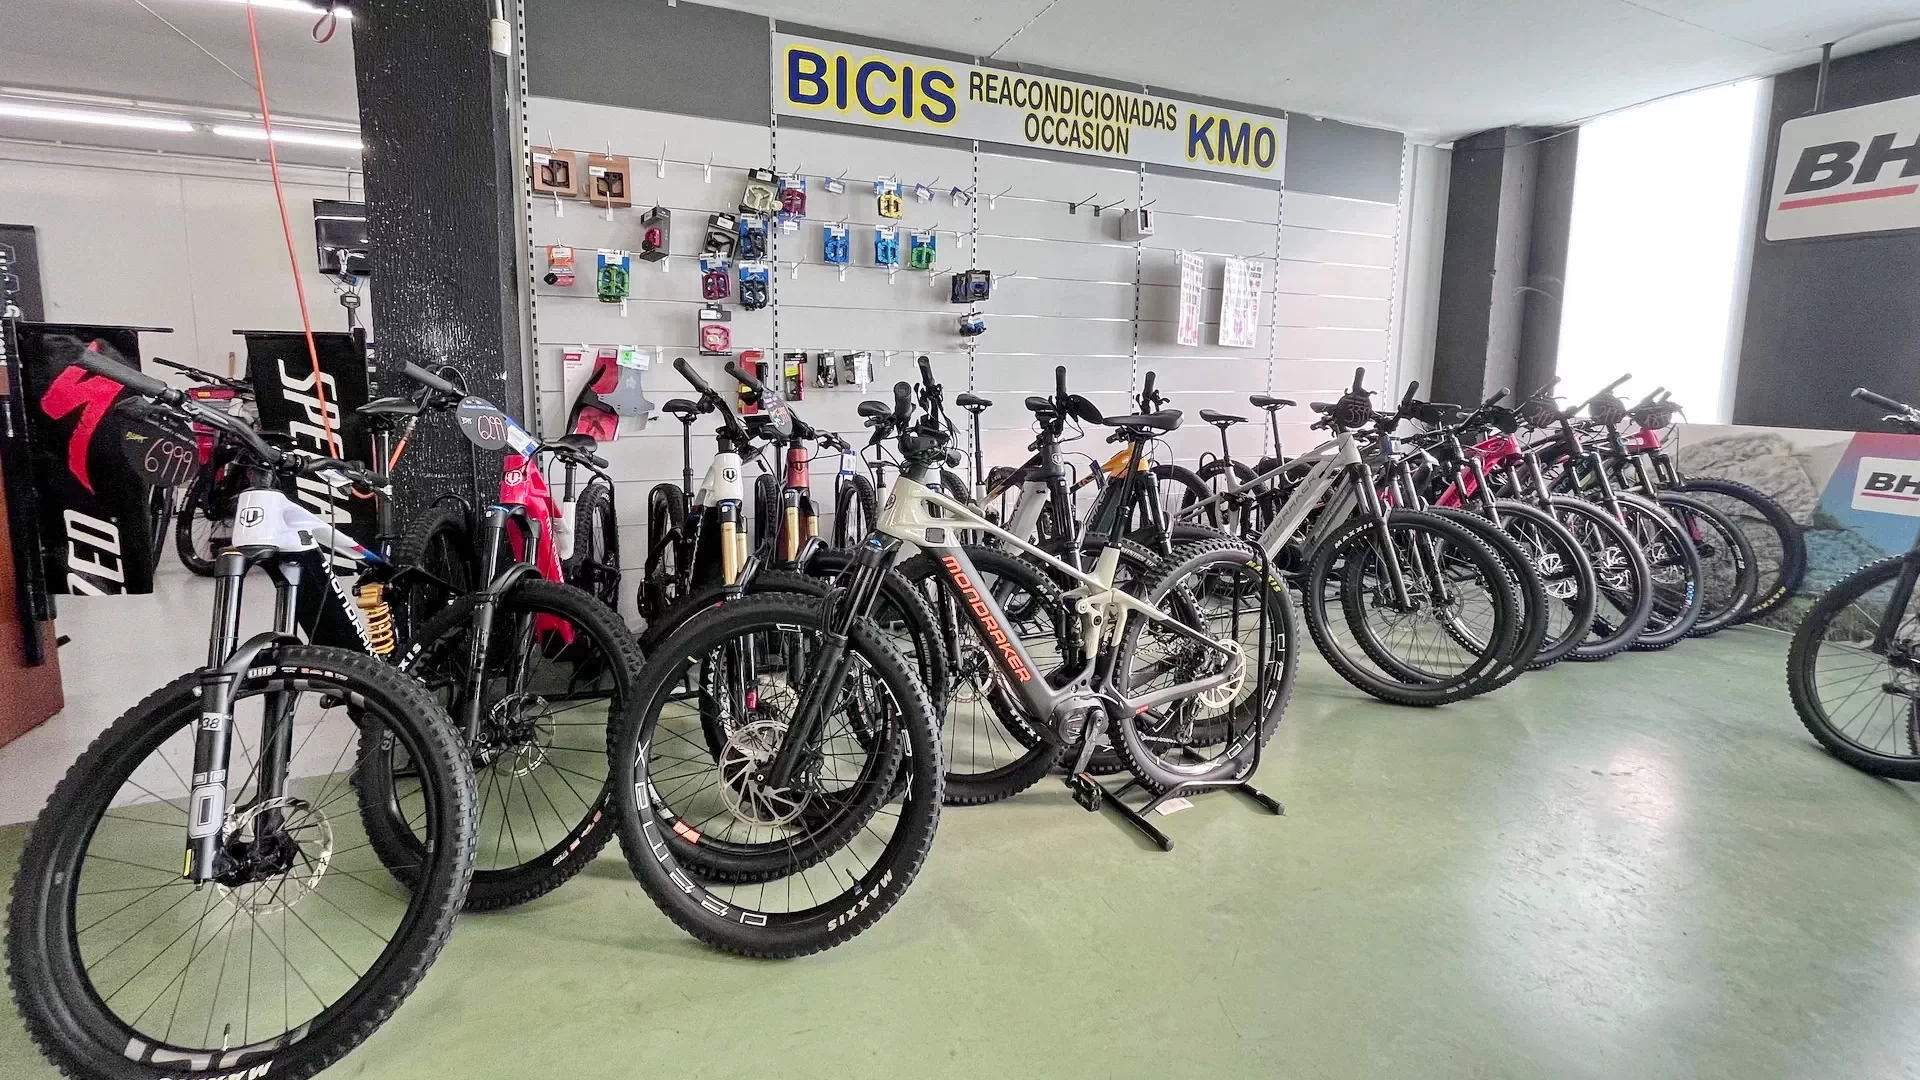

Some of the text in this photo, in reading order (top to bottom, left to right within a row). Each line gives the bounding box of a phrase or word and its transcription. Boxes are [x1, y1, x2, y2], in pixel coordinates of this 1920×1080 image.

[787, 49, 957, 124] BICIS
[968, 71, 1178, 131] REACONDICIONADAS
[1024, 113, 1130, 155] OCCASION
[1784, 133, 1920, 195] BH
[144, 438, 193, 484] 6999
[1864, 470, 1920, 495] BH
[1262, 474, 1318, 543] ONDRAKER
[1334, 521, 1374, 550] MAXXIS
[1245, 559, 1283, 594] MAXIS
[941, 554, 1032, 683] MONDRAKER
[397, 641, 422, 672] XIS
[201, 716, 220, 730] 38
[827, 868, 893, 932] MAXXIS
